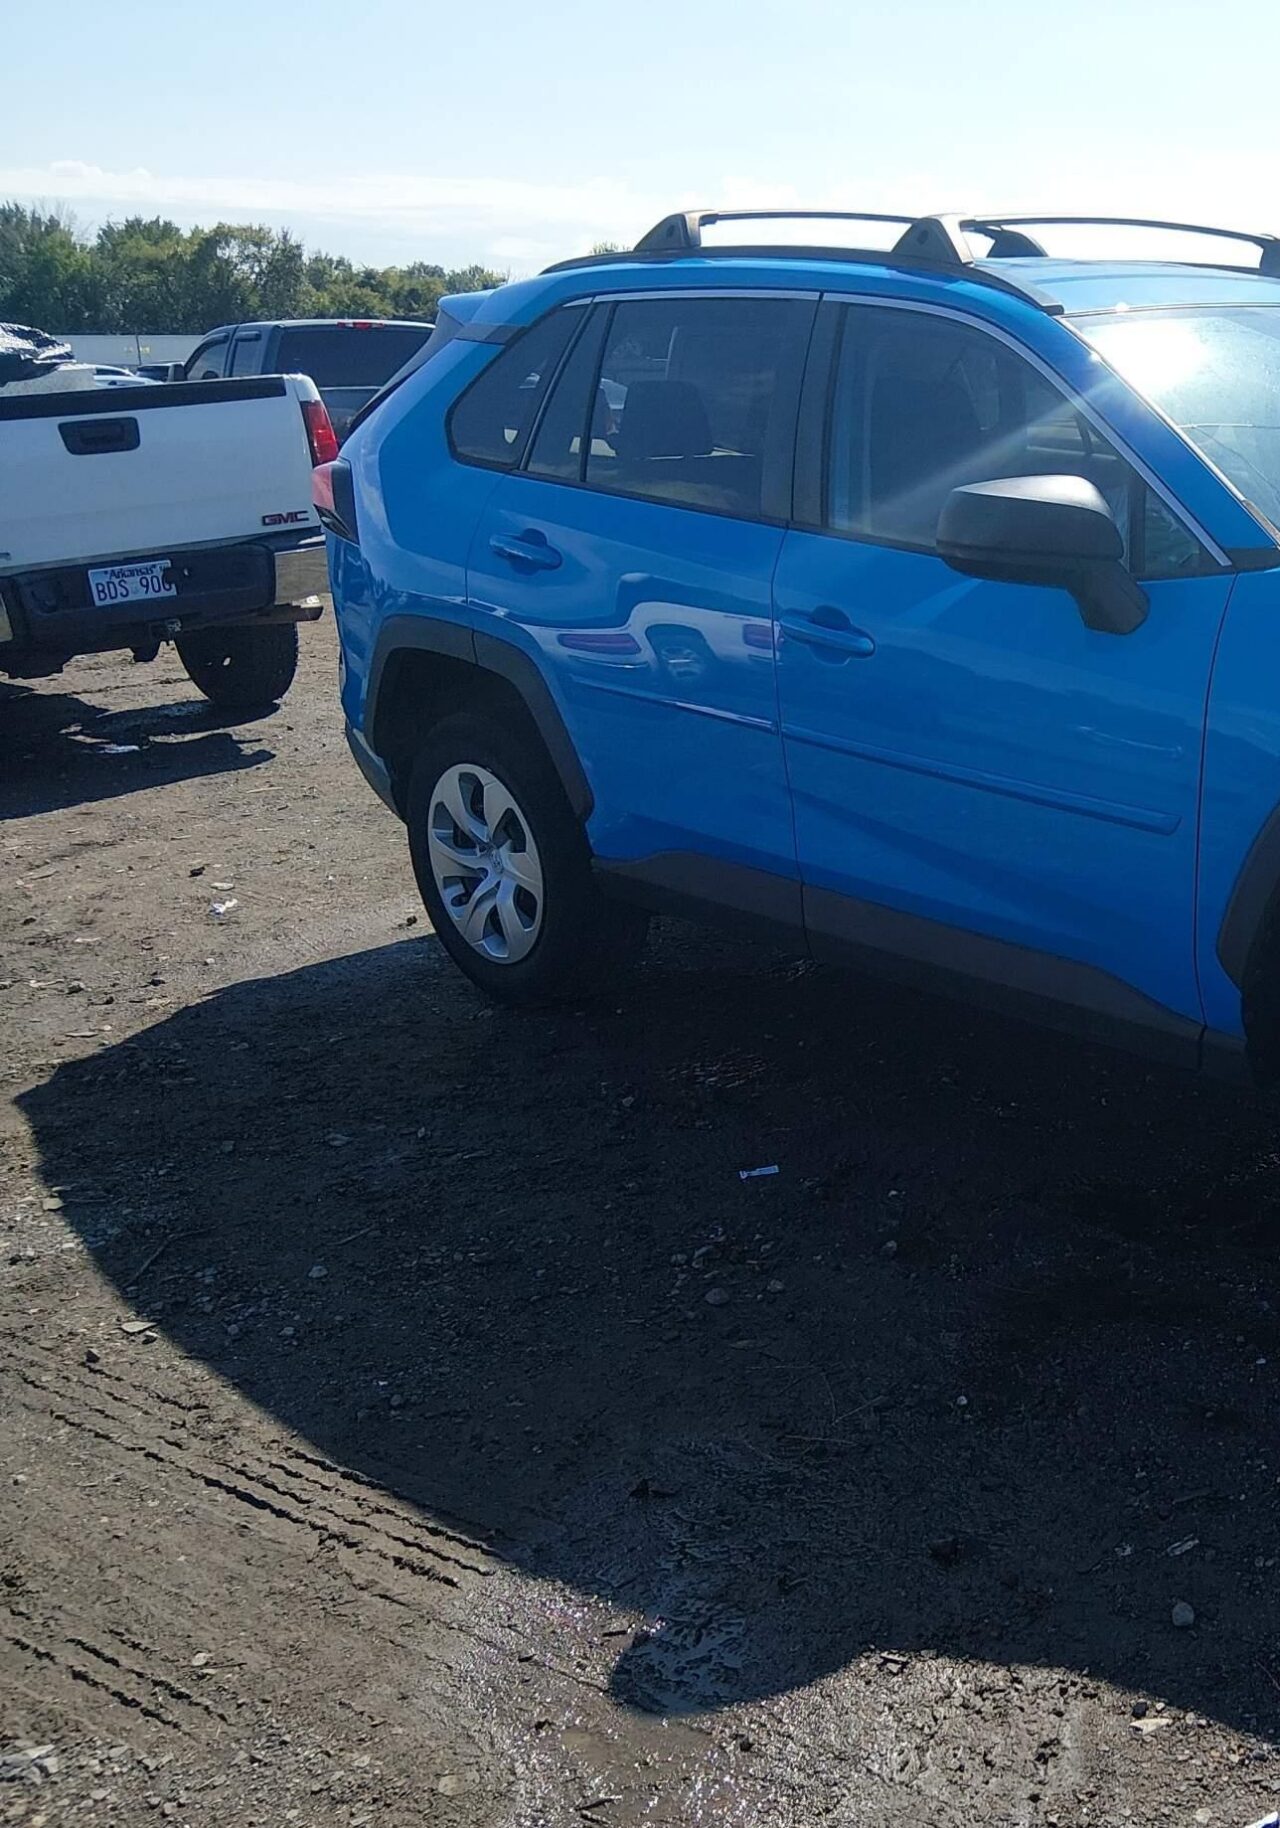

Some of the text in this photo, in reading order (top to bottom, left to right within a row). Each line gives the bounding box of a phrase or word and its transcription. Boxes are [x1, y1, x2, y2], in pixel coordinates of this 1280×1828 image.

[262, 510, 310, 526] GMC
[109, 565, 154, 580] Arkansas
[95, 579, 129, 602] BDS
